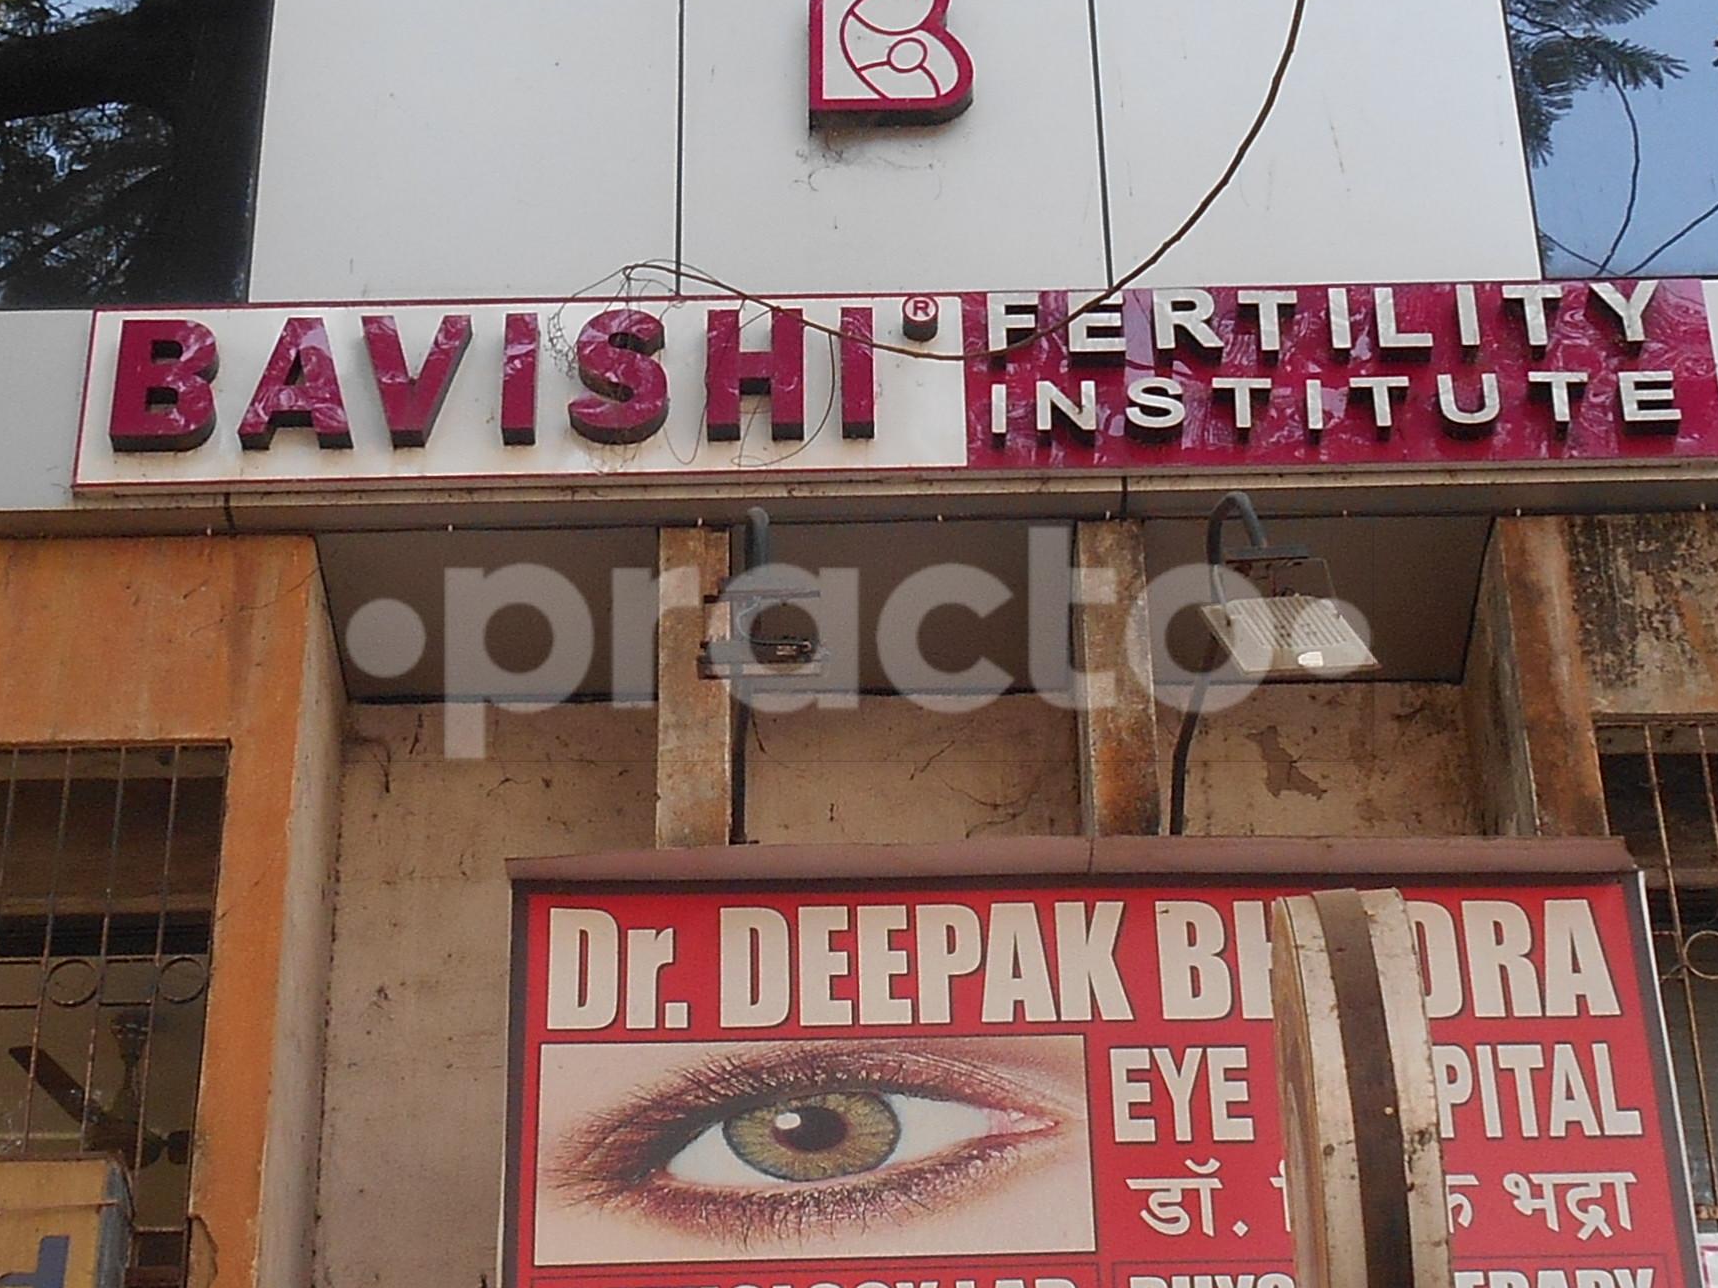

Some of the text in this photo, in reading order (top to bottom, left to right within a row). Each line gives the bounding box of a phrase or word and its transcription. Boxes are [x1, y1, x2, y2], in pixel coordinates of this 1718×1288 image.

[986, 280, 1660, 357] FERTILITY
[990, 369, 1683, 442] INSTITUTE
[546, 907, 688, 1033] Dr.
[727, 900, 1133, 1029] DEEPAK
[1110, 1043, 1643, 1143] EYE PITAL
[1502, 1172, 1637, 1240] भद्रा
